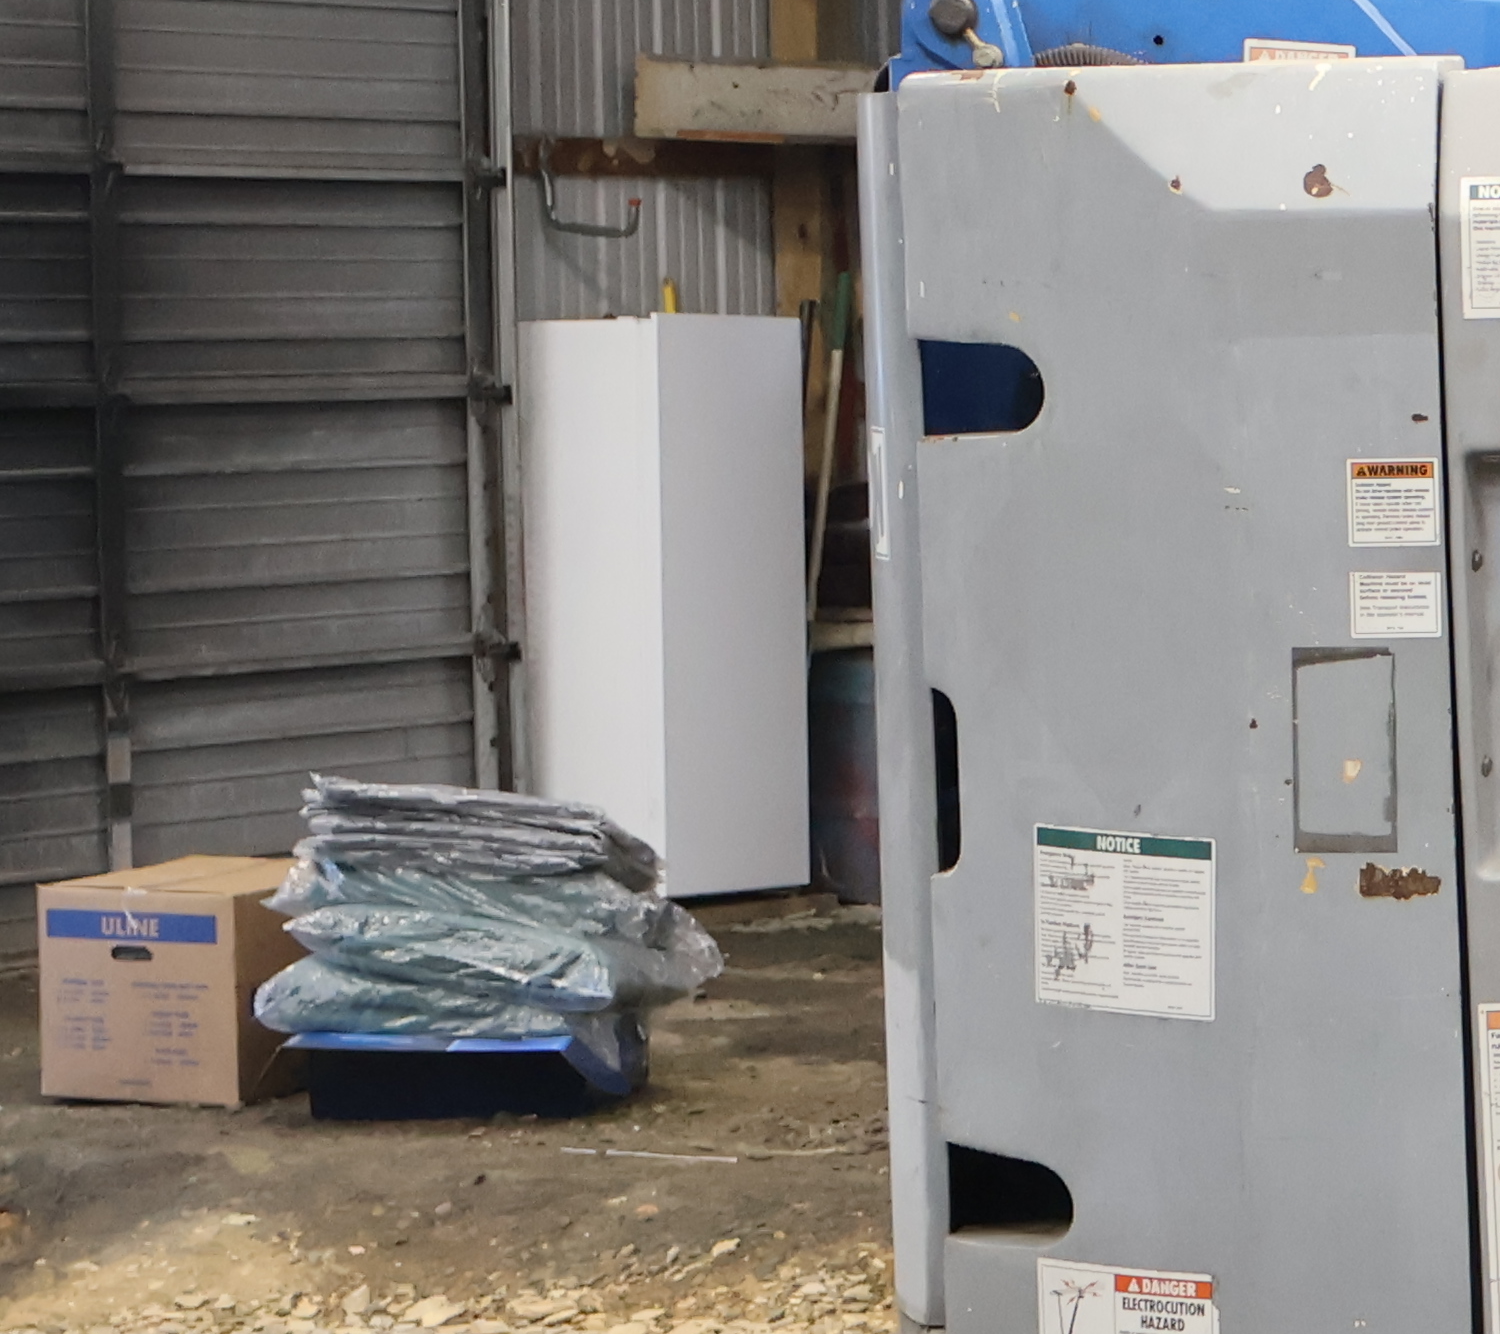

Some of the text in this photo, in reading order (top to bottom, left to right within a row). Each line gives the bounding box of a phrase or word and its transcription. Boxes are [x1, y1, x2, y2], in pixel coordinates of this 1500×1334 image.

[1366, 464, 1428, 476] WARNING
[1096, 835, 1142, 854] NOTICE
[101, 916, 160, 938] ULINE
[1141, 1280, 1197, 1297] DANGER
[1122, 1297, 1205, 1317] ELECTROCUTION
[1140, 1316, 1185, 1332] HAZARD
